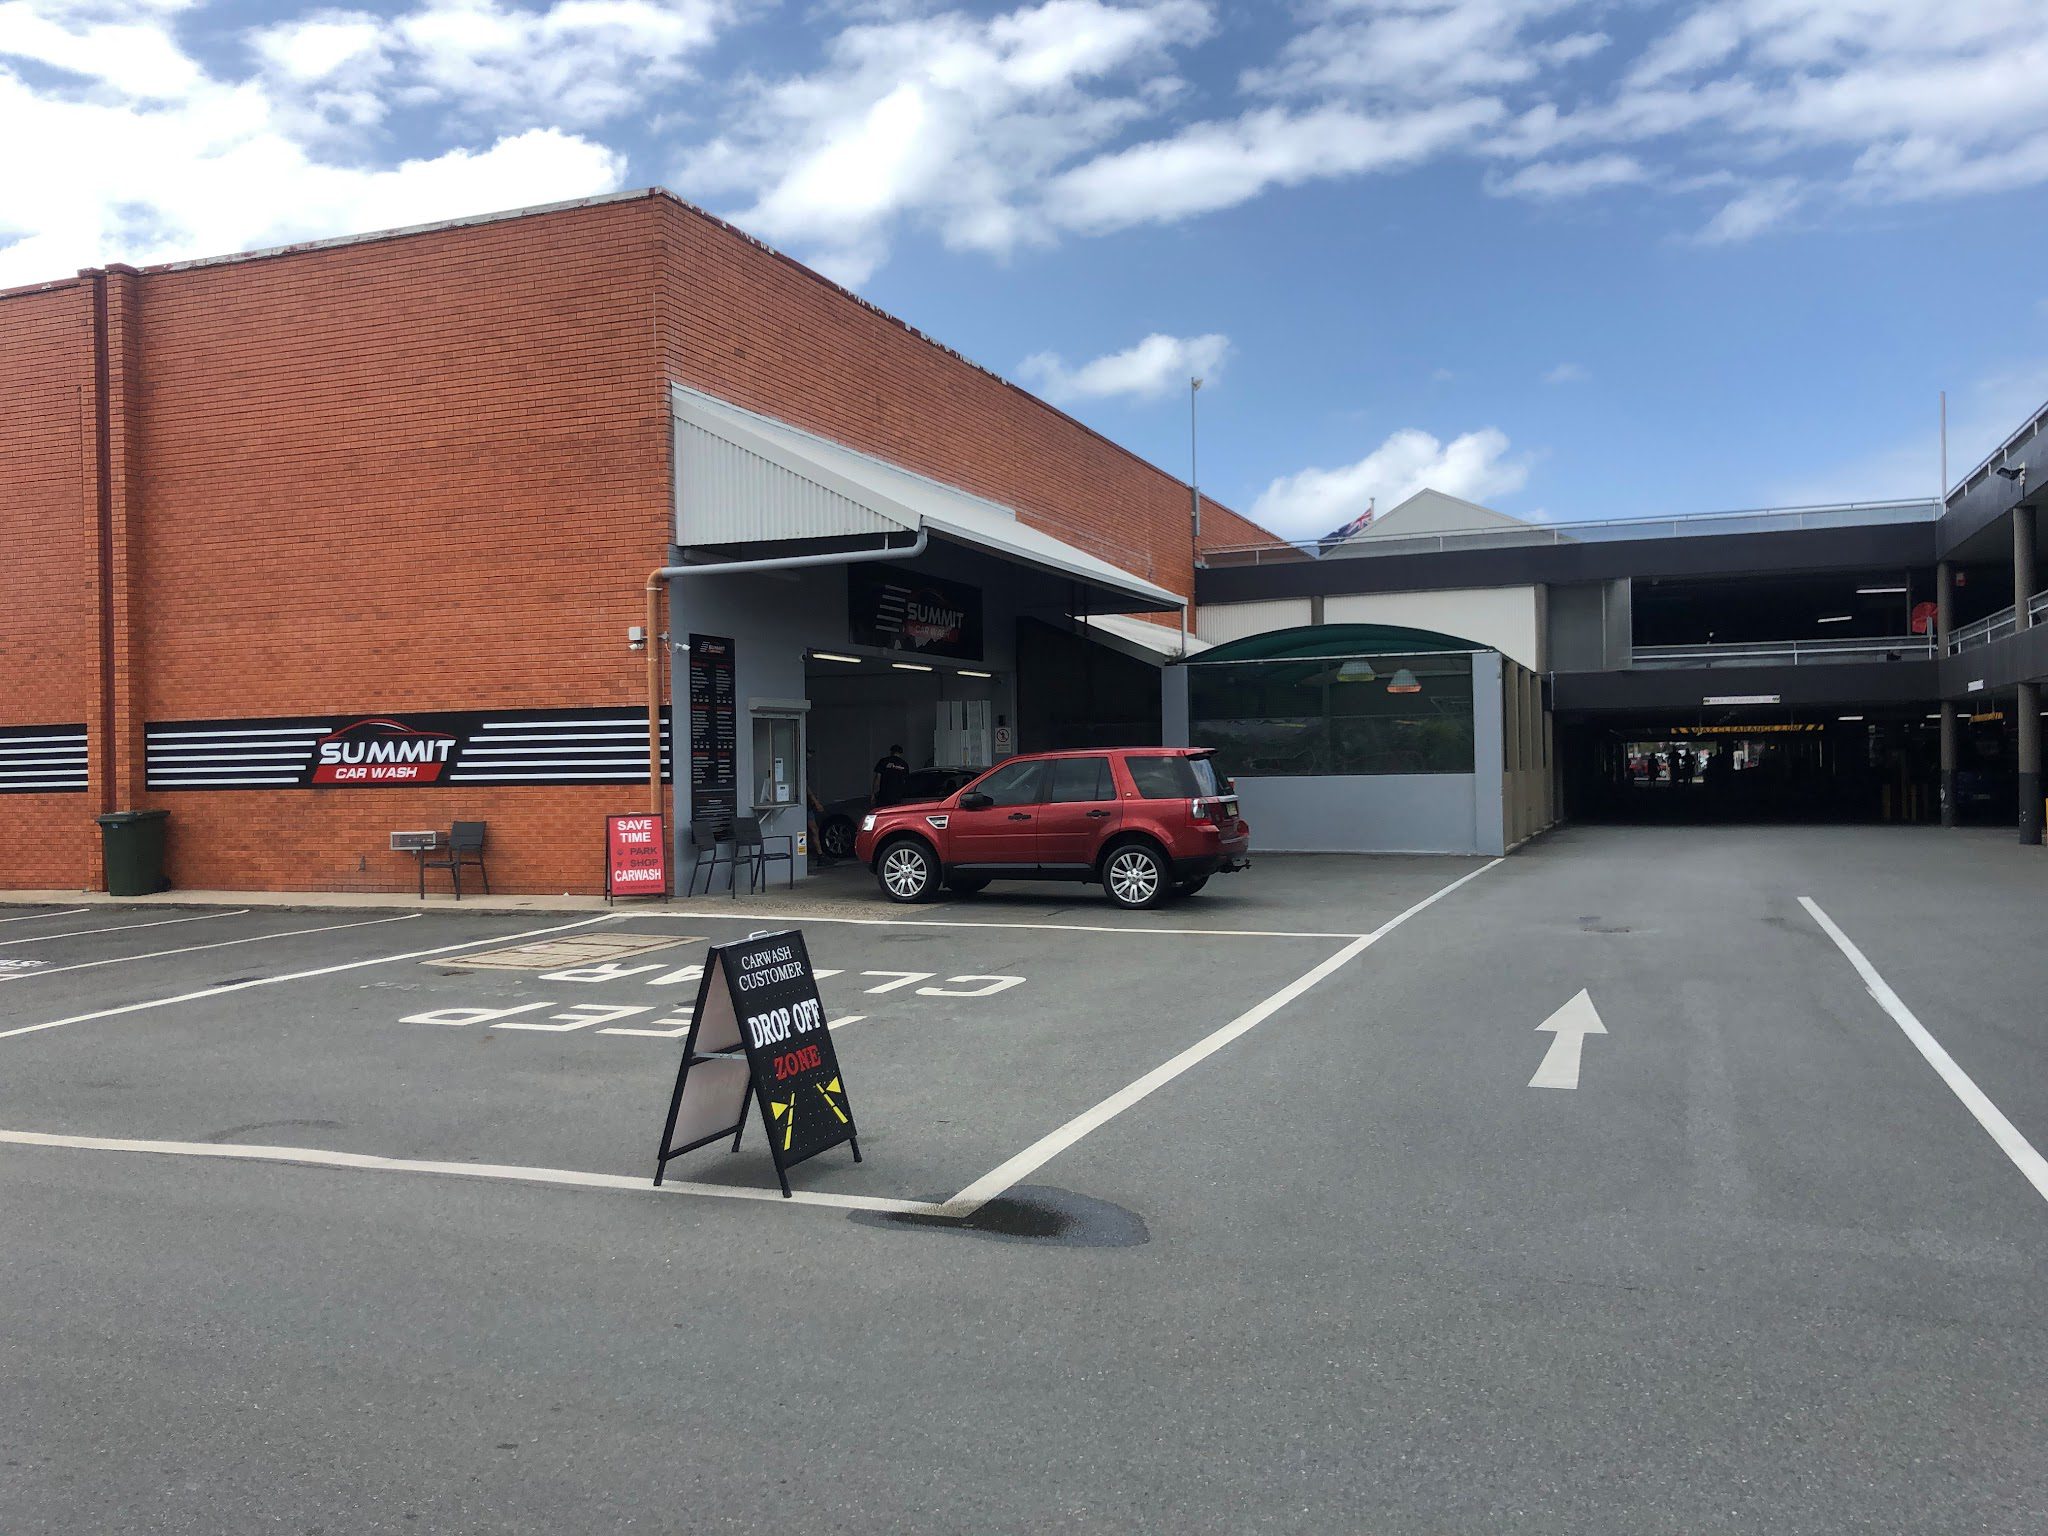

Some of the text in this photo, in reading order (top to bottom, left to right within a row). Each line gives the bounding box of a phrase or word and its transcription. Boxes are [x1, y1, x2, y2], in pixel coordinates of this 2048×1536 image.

[907, 601, 964, 628] SUMMIT
[1716, 725, 1774, 733] CLEARANCE
[319, 739, 457, 765] SUMMIT
[335, 766, 418, 780] CAR WASH
[617, 819, 652, 831] SAVE
[620, 832, 651, 843] TIME
[630, 847, 657, 856] PARK
[630, 859, 659, 867] SHOP
[615, 868, 661, 882] CARWASH
[741, 946, 793, 970] CARWASH
[739, 961, 804, 992] CUSTOMER
[398, 1001, 868, 1038] EEP
[747, 998, 821, 1049] DROP OFF
[773, 1044, 822, 1081] ZONE
